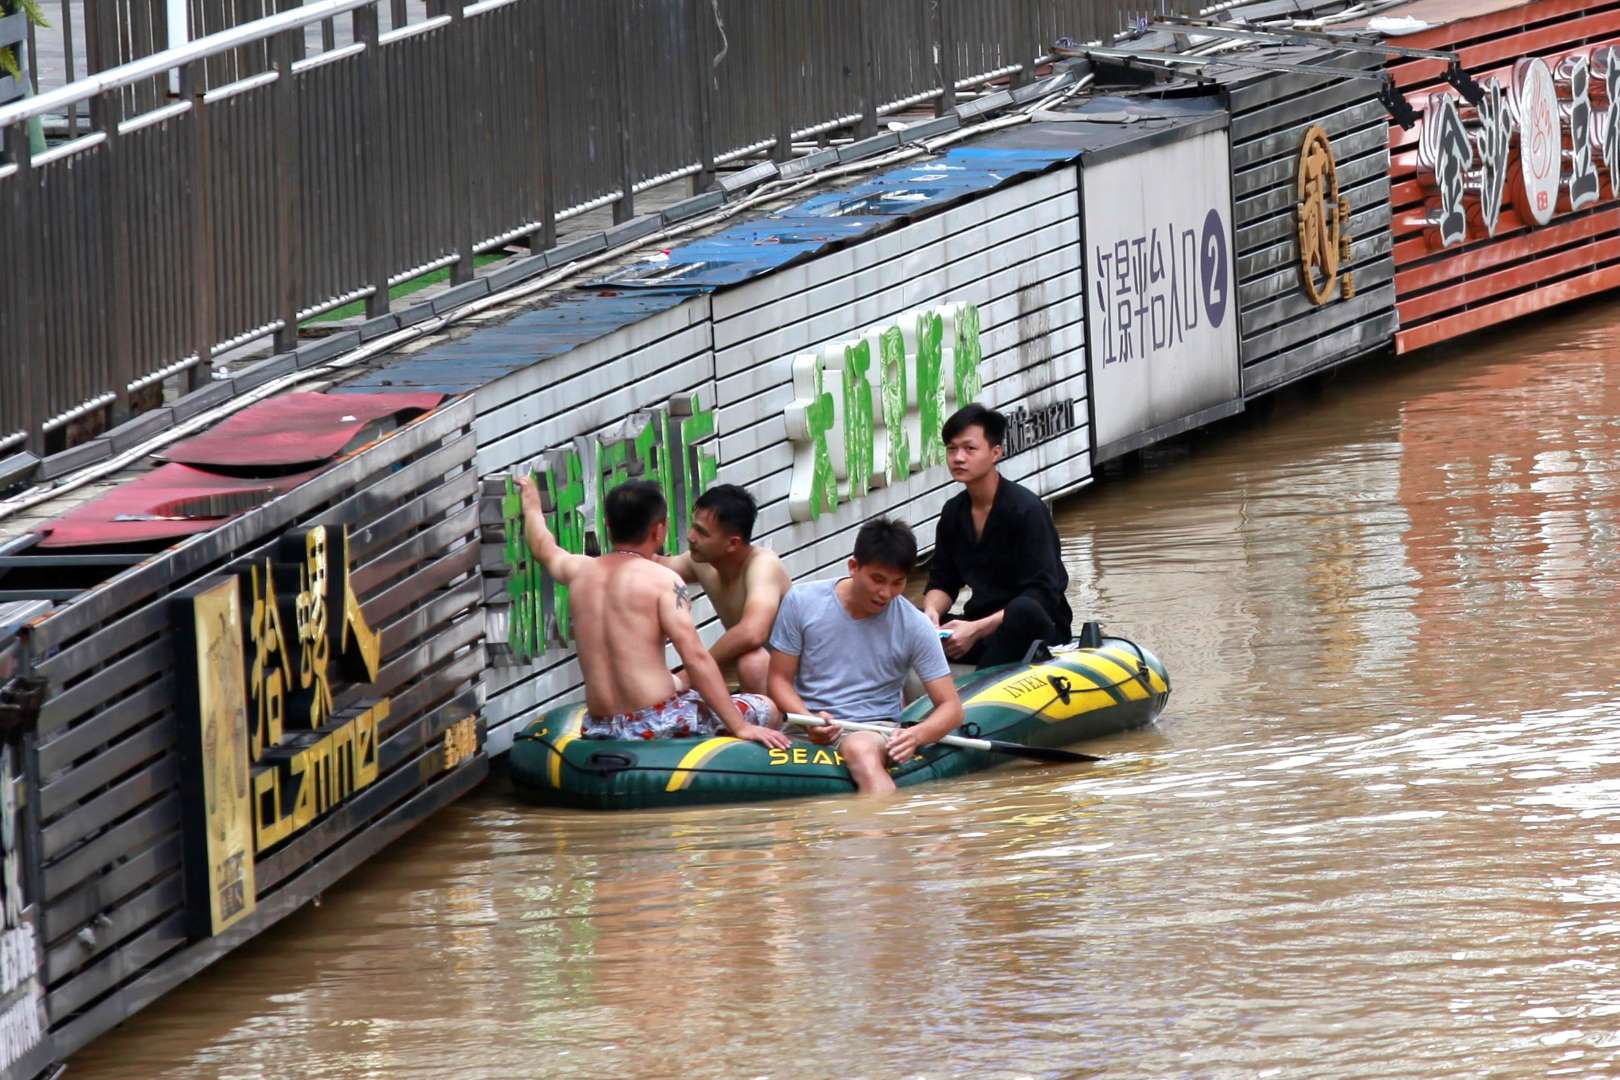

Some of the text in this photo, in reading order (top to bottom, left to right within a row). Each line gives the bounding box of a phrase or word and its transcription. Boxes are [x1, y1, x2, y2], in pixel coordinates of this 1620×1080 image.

[1097, 222, 1198, 368] 江景平台入口
[1003, 675, 1048, 699] INTEX
